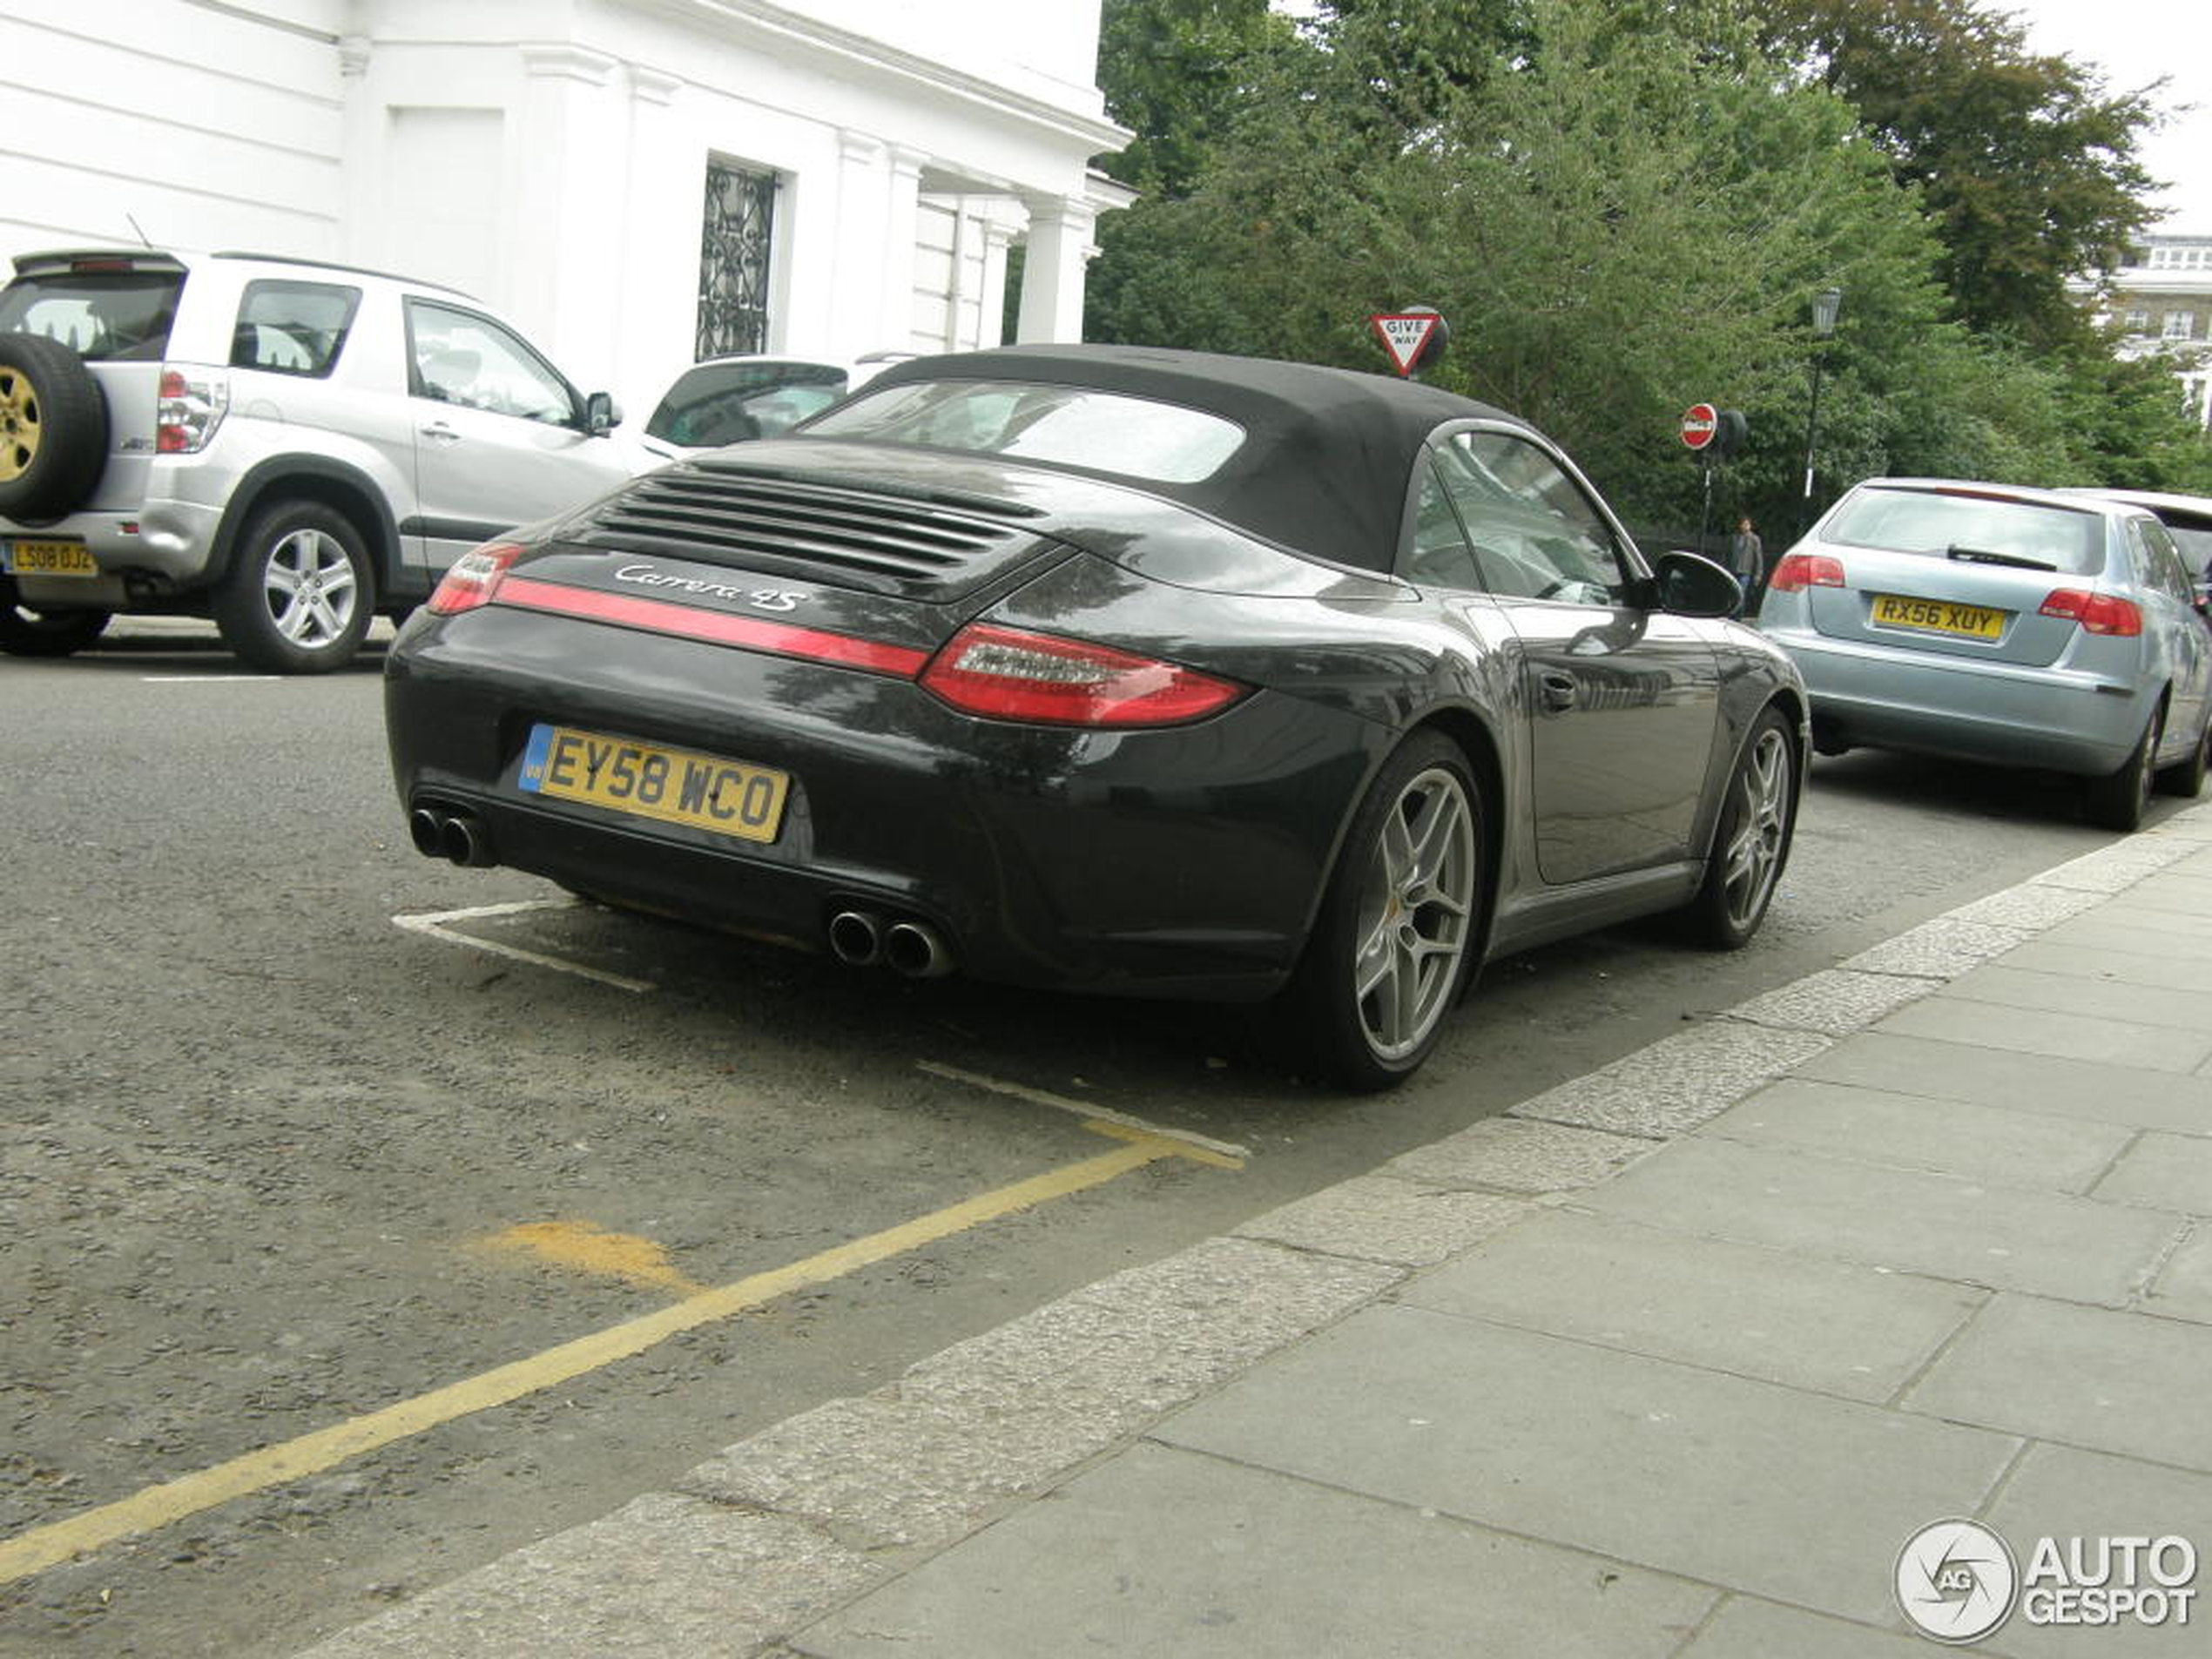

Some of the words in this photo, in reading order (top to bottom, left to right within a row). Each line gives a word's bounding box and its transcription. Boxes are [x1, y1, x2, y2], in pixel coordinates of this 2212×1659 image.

[1386, 320, 1425, 333] GIVE
[1394, 336, 1417, 345] WAY
[615, 565, 741, 601] Carrera
[750, 589, 807, 611] 4S
[1881, 598, 1942, 625] RX56
[1946, 607, 1993, 632] XUY
[549, 736, 671, 805] EY58
[678, 760, 775, 826] WCO
